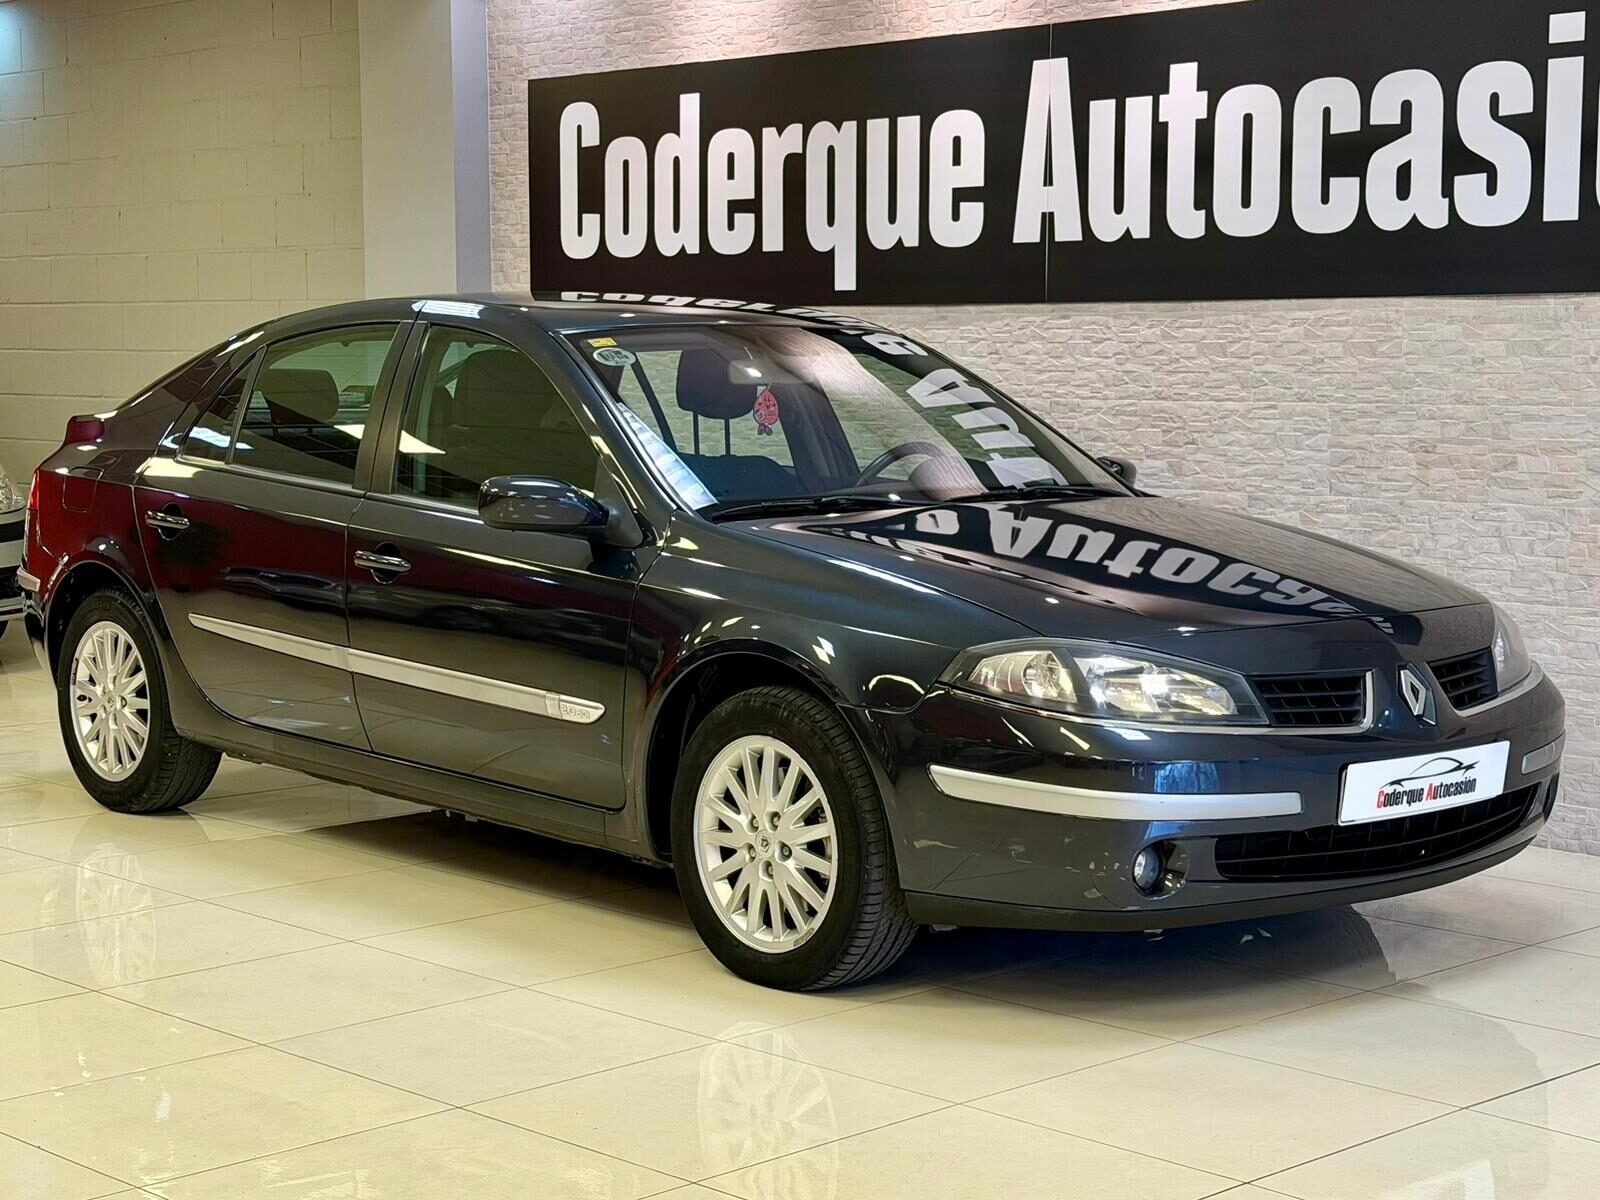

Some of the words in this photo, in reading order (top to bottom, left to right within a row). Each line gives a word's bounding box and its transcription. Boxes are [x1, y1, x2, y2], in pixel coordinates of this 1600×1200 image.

[559, 92, 985, 292] Coderque
[1012, 10, 1600, 244] Autocasi
[1376, 787, 1425, 808] Coderque
[1426, 775, 1477, 800] Autocasión
